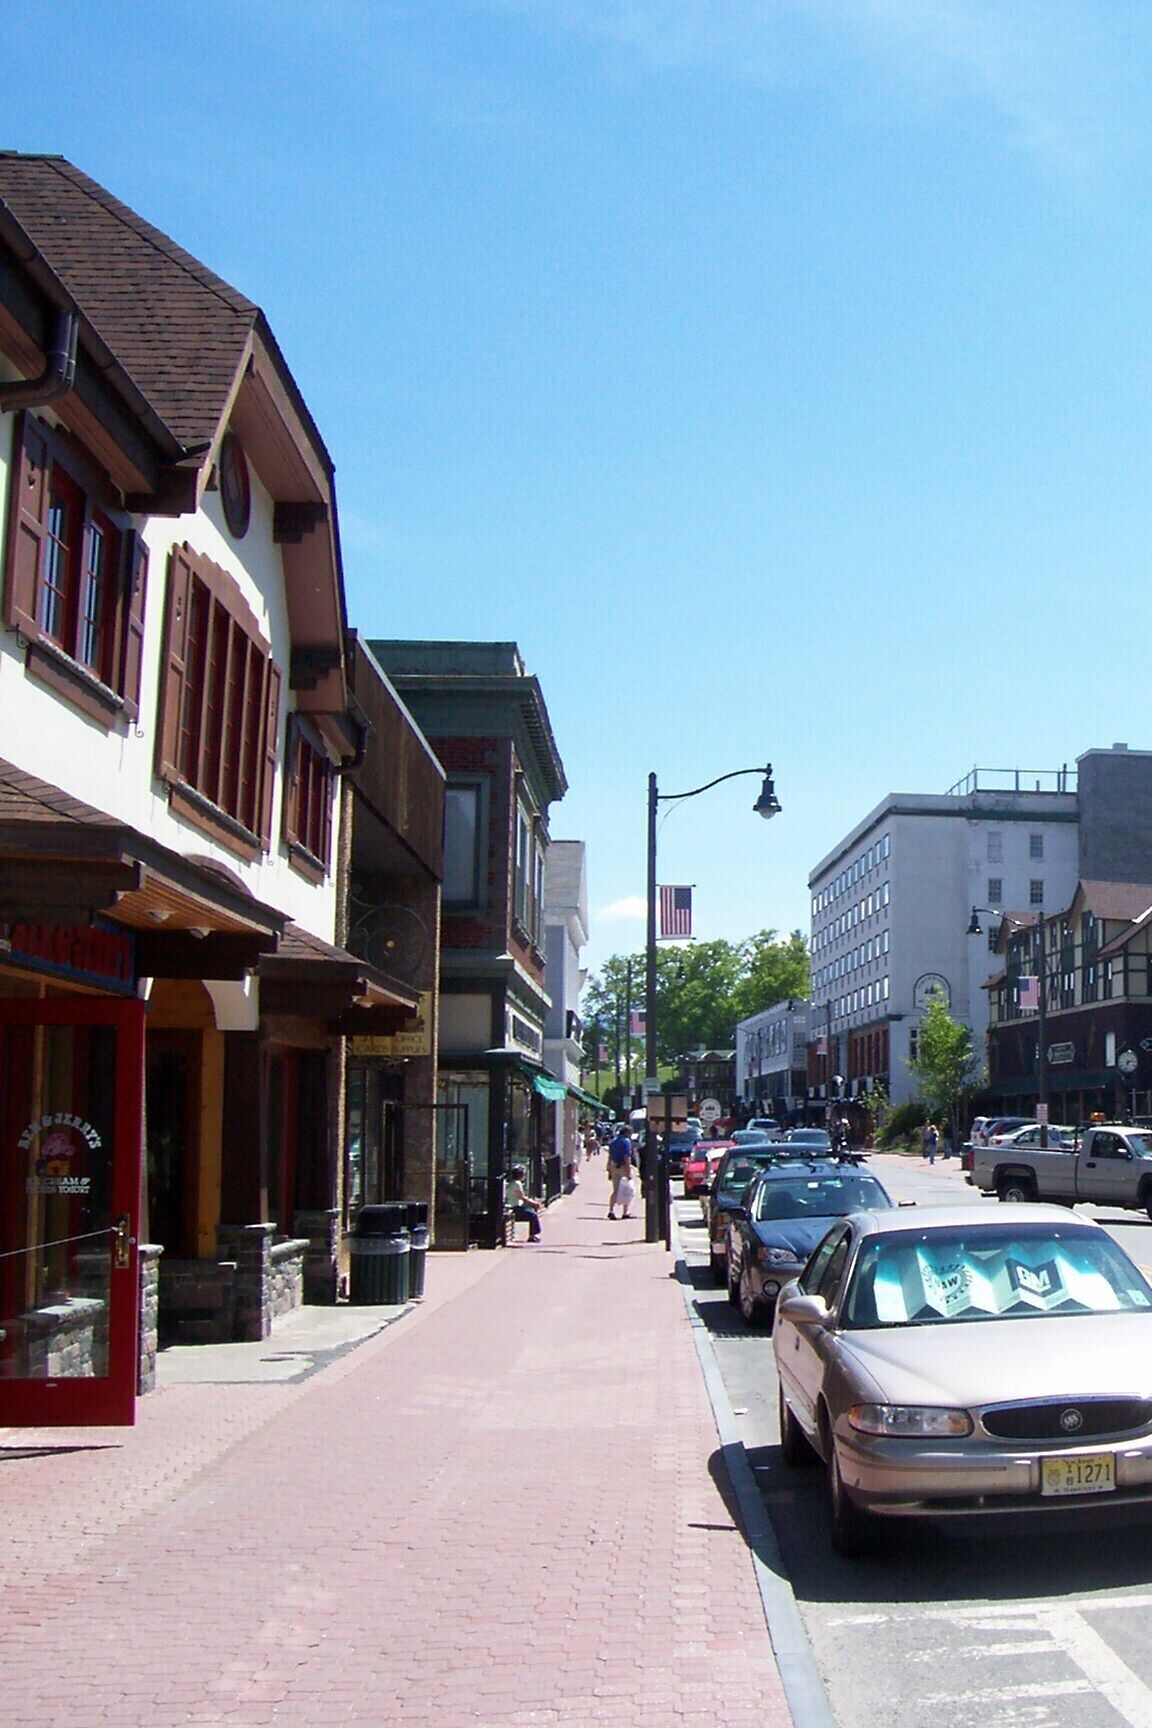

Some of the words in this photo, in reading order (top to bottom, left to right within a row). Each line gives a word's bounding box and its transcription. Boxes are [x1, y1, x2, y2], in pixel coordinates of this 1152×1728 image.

[17, 1121, 42, 1150] BEN
[1016, 1265, 1052, 1292] GM
[1077, 1464, 1110, 1484] 1271
